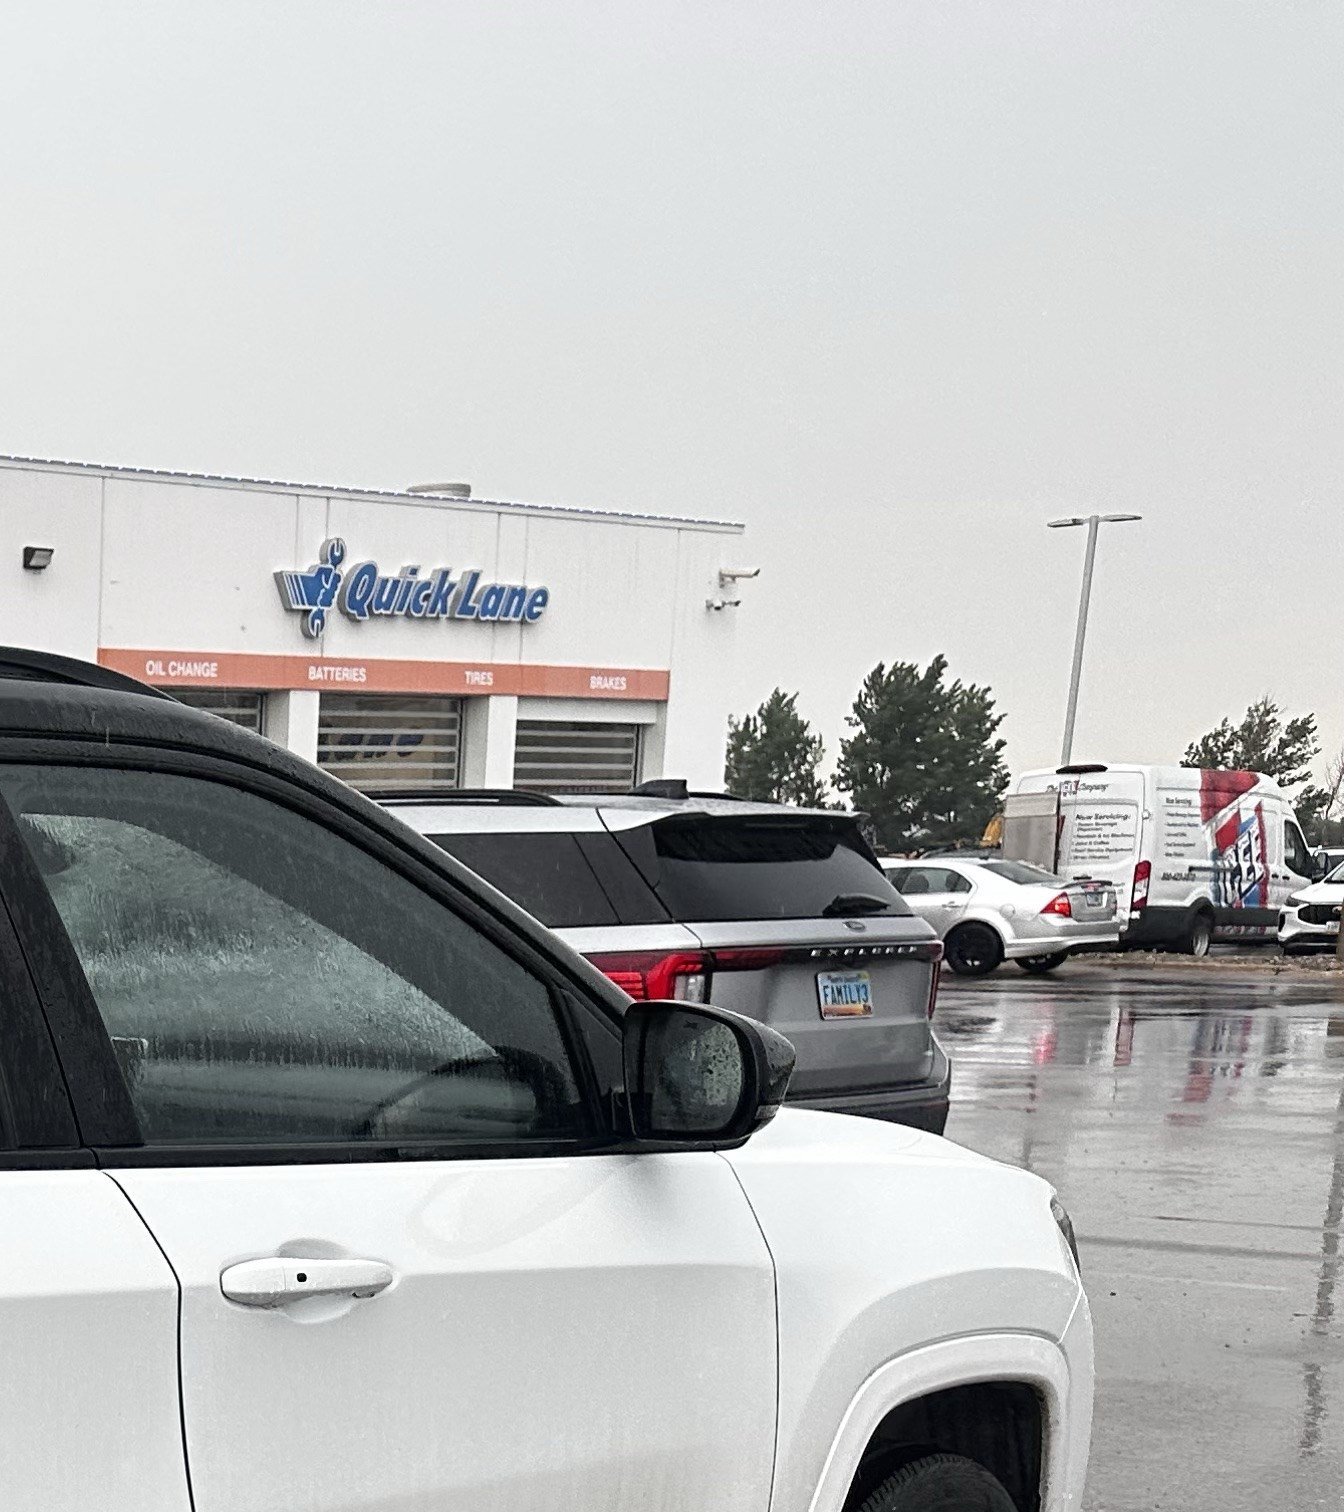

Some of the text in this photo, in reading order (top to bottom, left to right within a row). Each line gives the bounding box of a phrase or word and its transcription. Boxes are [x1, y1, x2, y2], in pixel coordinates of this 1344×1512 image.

[343, 561, 549, 623] Quick Lane
[145, 660, 218, 678] OIL CHANGE
[308, 665, 367, 682] BATTERIES
[465, 671, 494, 686] TIRES
[589, 676, 627, 691] BRAKES
